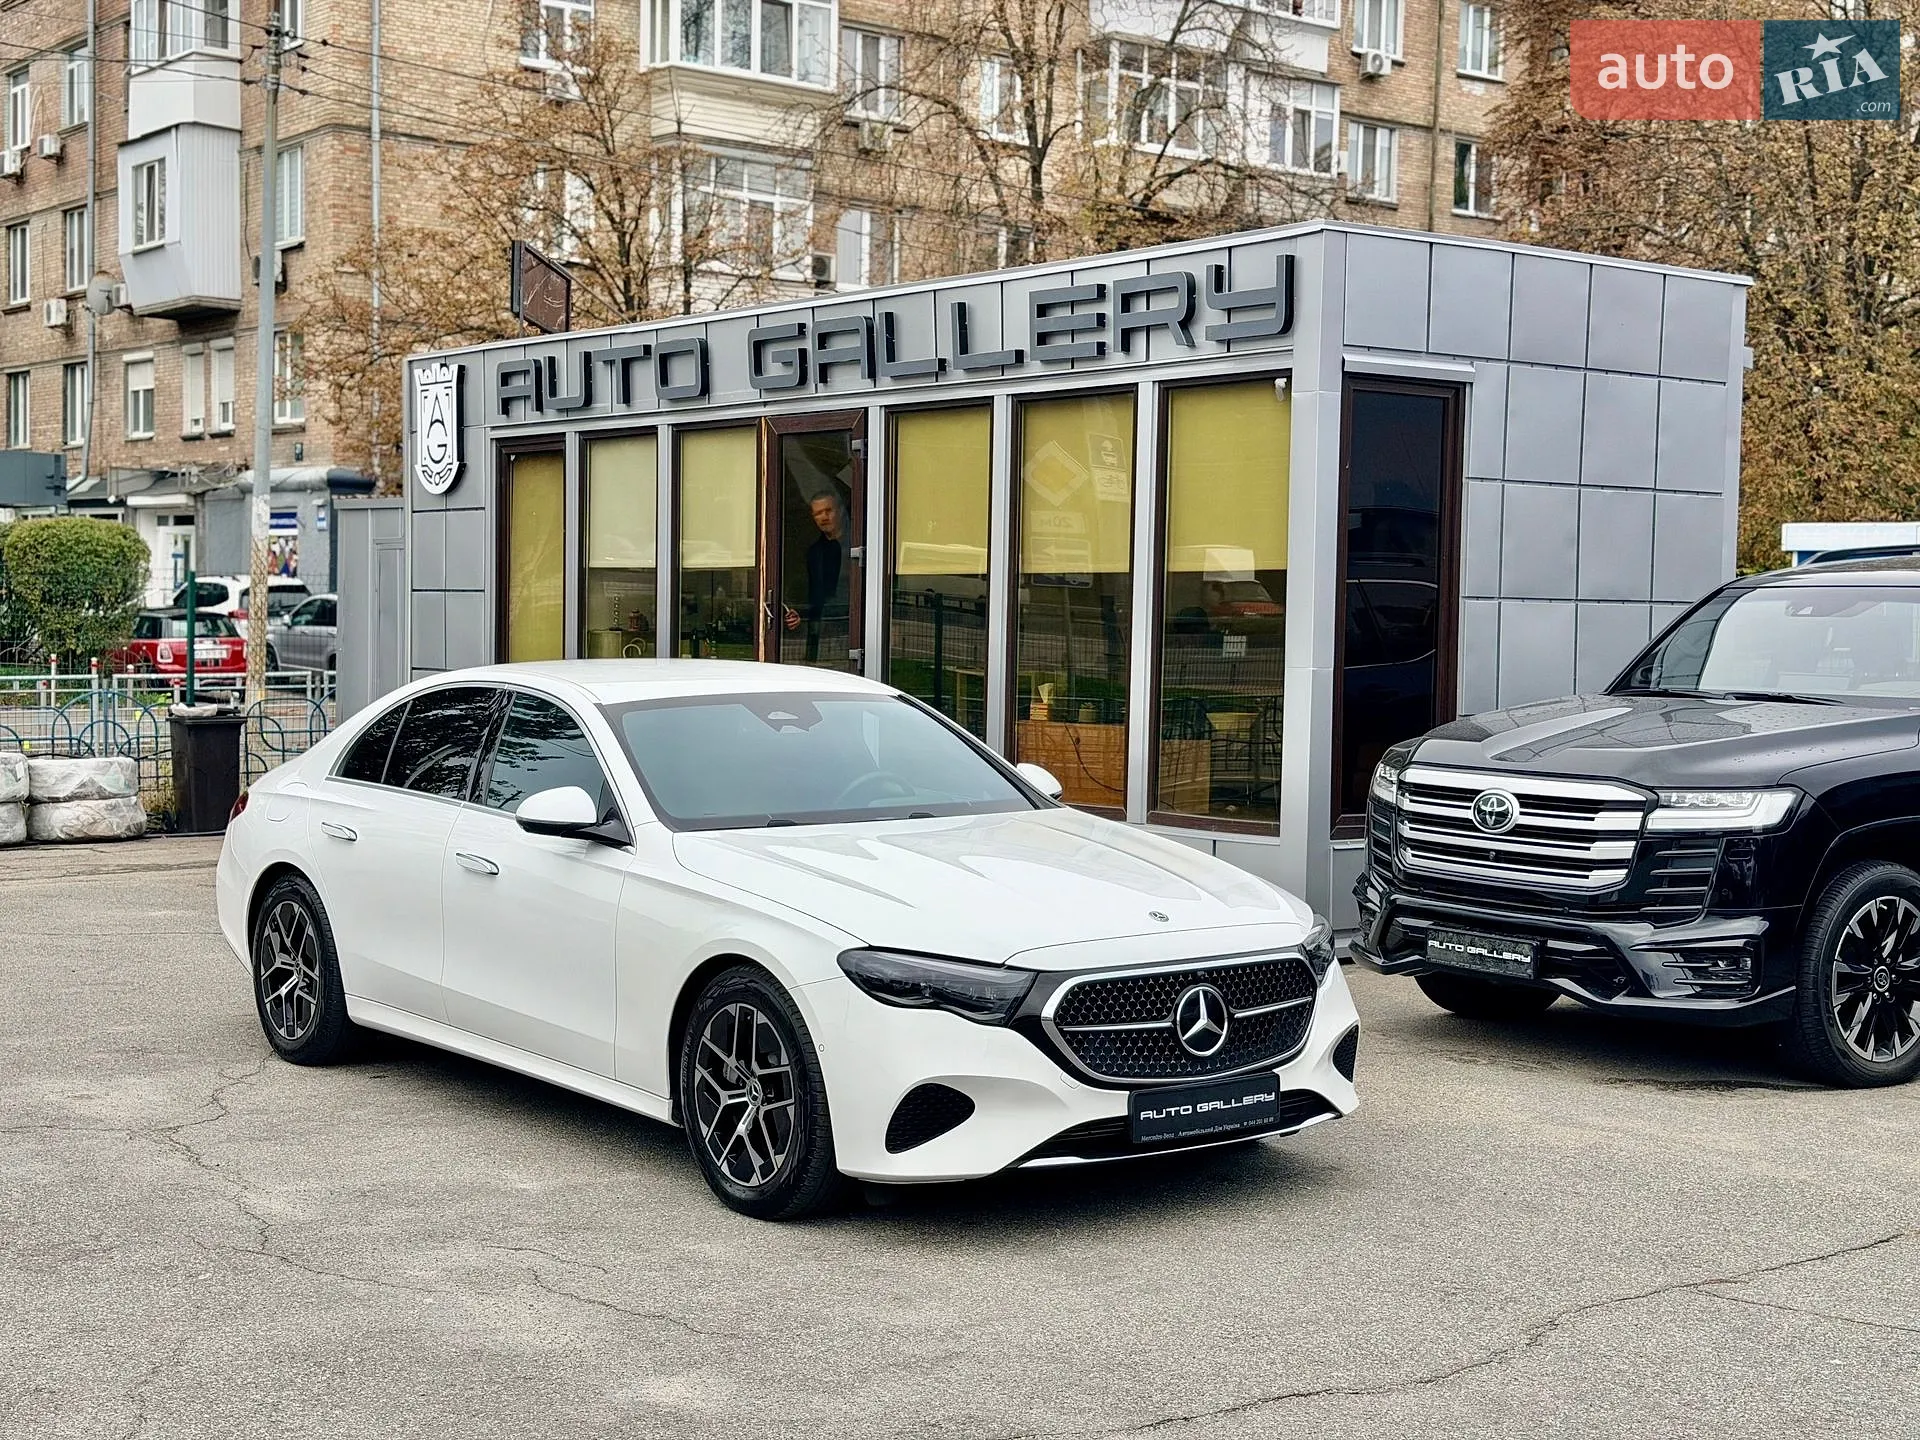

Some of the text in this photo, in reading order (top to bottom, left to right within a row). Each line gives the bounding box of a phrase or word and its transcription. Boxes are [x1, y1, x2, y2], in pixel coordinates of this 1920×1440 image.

[495, 254, 1295, 416] AUTO GALLERY
[1428, 940, 1464, 952] AUTO
[1467, 945, 1531, 963] GALLERY
[1140, 1092, 1275, 1120] AUTO GALLERY
